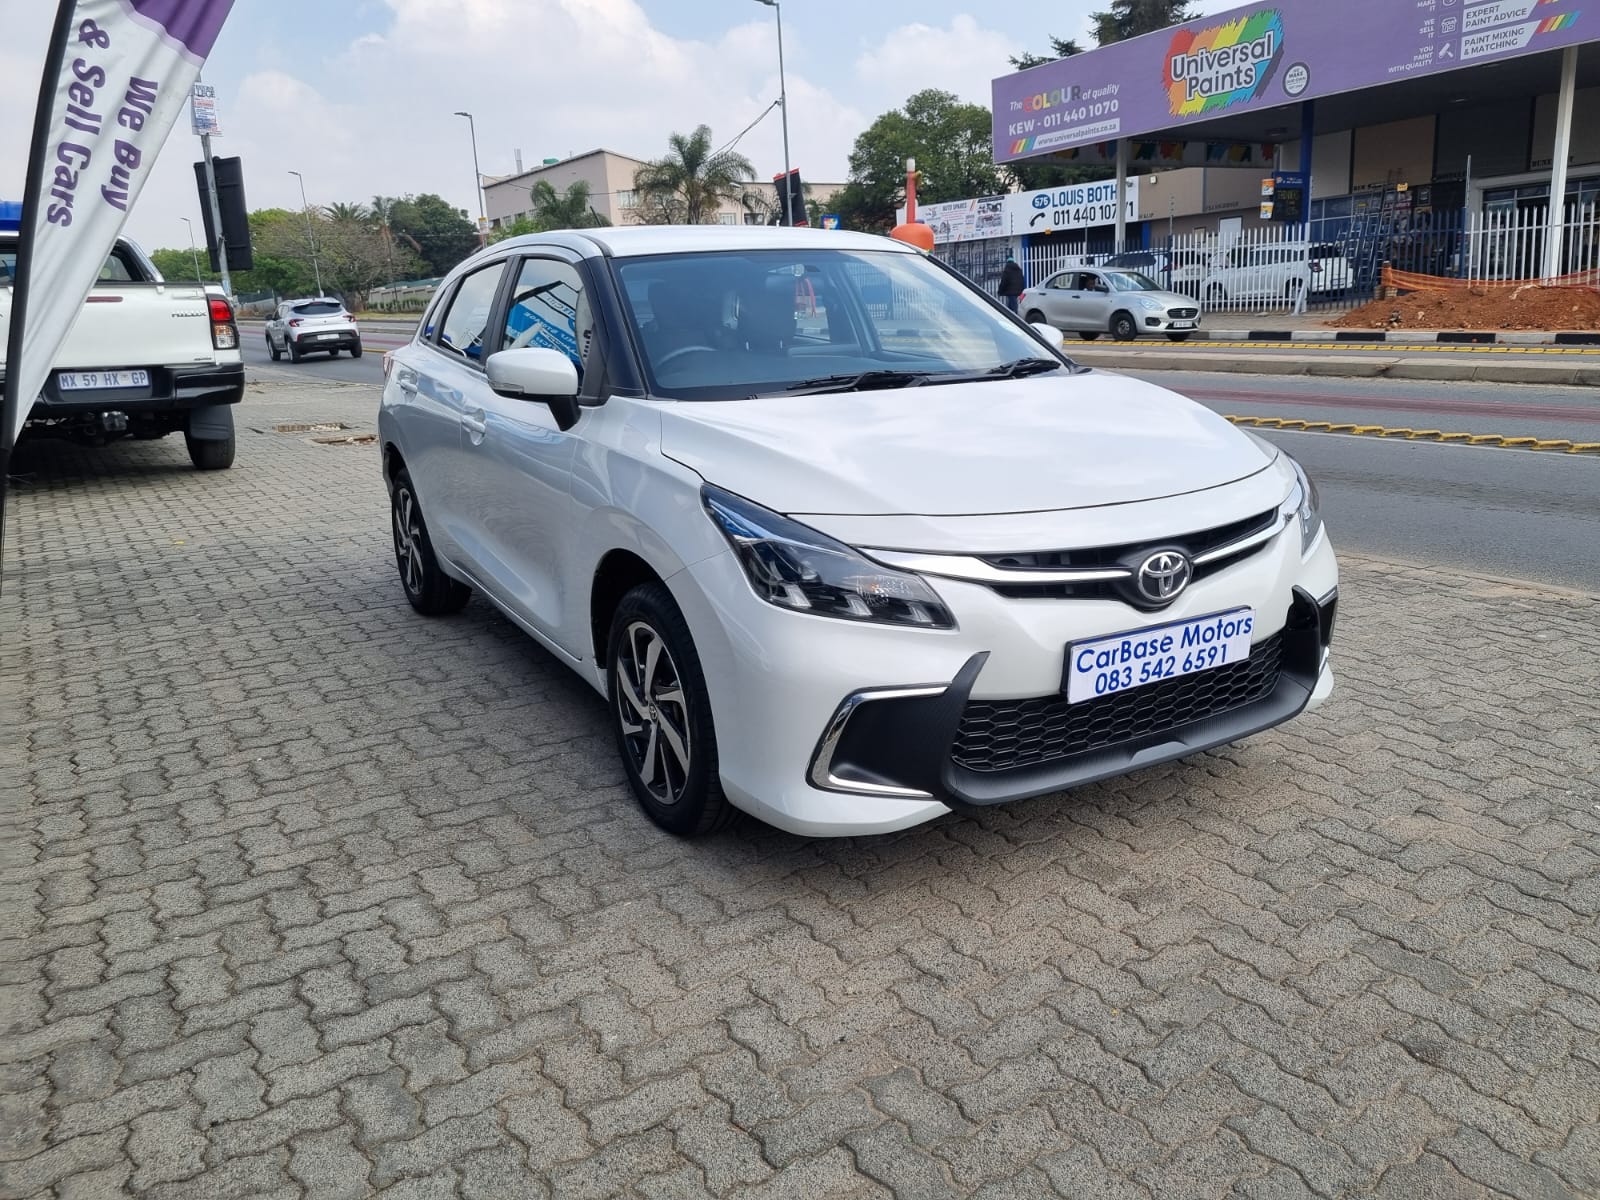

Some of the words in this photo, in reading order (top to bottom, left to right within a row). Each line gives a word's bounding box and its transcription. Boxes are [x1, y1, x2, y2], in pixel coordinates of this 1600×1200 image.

[1465, 16, 1491, 29] PAINT
[1493, 7, 1528, 21] ADVICE
[1466, 5, 1500, 19] EXPERT
[78, 18, 110, 49] &
[1464, 35, 1490, 47] PAINT
[1492, 27, 1525, 41] MIXING
[1172, 32, 1273, 80] Universal
[1413, 52, 1433, 61] PAINT
[1419, 45, 1434, 53] YOU
[1471, 38, 1518, 55] MATCHING
[1405, 58, 1433, 71] QUALITY
[1187, 64, 1254, 99] Paints
[64, 58, 106, 136] Sell
[117, 76, 158, 132] We
[1010, 101, 1022, 111] The
[1024, 85, 1081, 112] COLOUR
[1082, 91, 1091, 100] of
[1092, 84, 1119, 100] quality
[1009, 119, 1035, 136] KEW
[1043, 112, 1061, 128] 011
[1063, 107, 1087, 123] 440
[1089, 99, 1119, 117] 1070
[1038, 124, 1117, 145] www.universalpaints.co.za
[46, 141, 92, 227] Cars
[101, 139, 142, 212] Buy
[1052, 188, 1084, 208] LOUIS
[1087, 185, 1117, 203] BOTH
[1053, 209, 1070, 226] 011
[1073, 206, 1096, 222] 440
[82, 374, 97, 387] 59
[104, 372, 120, 386] HX
[131, 371, 146, 385] GP
[1076, 635, 1174, 673] CarBase
[1180, 617, 1253, 649] Motors
[1095, 666, 1132, 695] 083
[1139, 655, 1176, 683] 542
[1182, 643, 1227, 672] 6591
